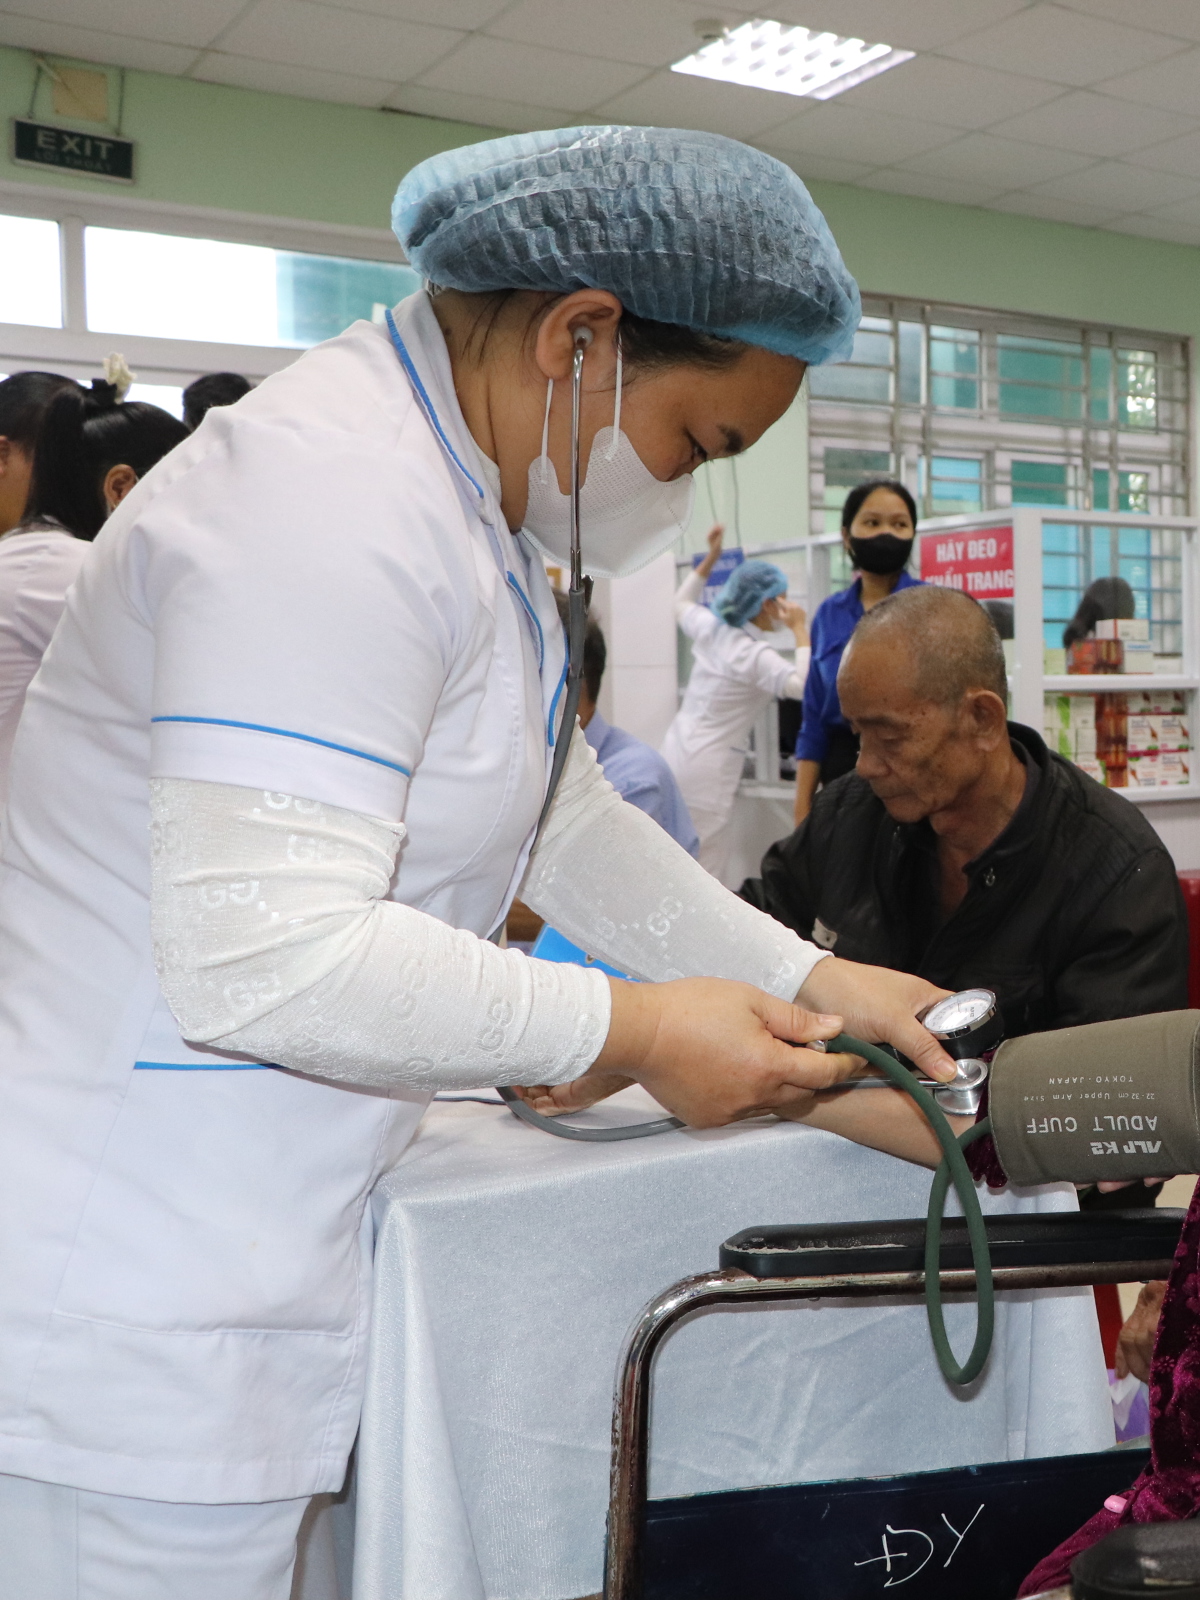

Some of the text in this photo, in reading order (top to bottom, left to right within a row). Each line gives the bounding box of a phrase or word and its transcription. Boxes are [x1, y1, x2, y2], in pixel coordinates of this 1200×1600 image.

[36, 129, 114, 160] EXIT
[966, 569, 1014, 591] TRANG
[1052, 1093, 1073, 1101] Arm
[1079, 1091, 1110, 1100] Upper
[1026, 1115, 1158, 1134] ADULT CUFF
